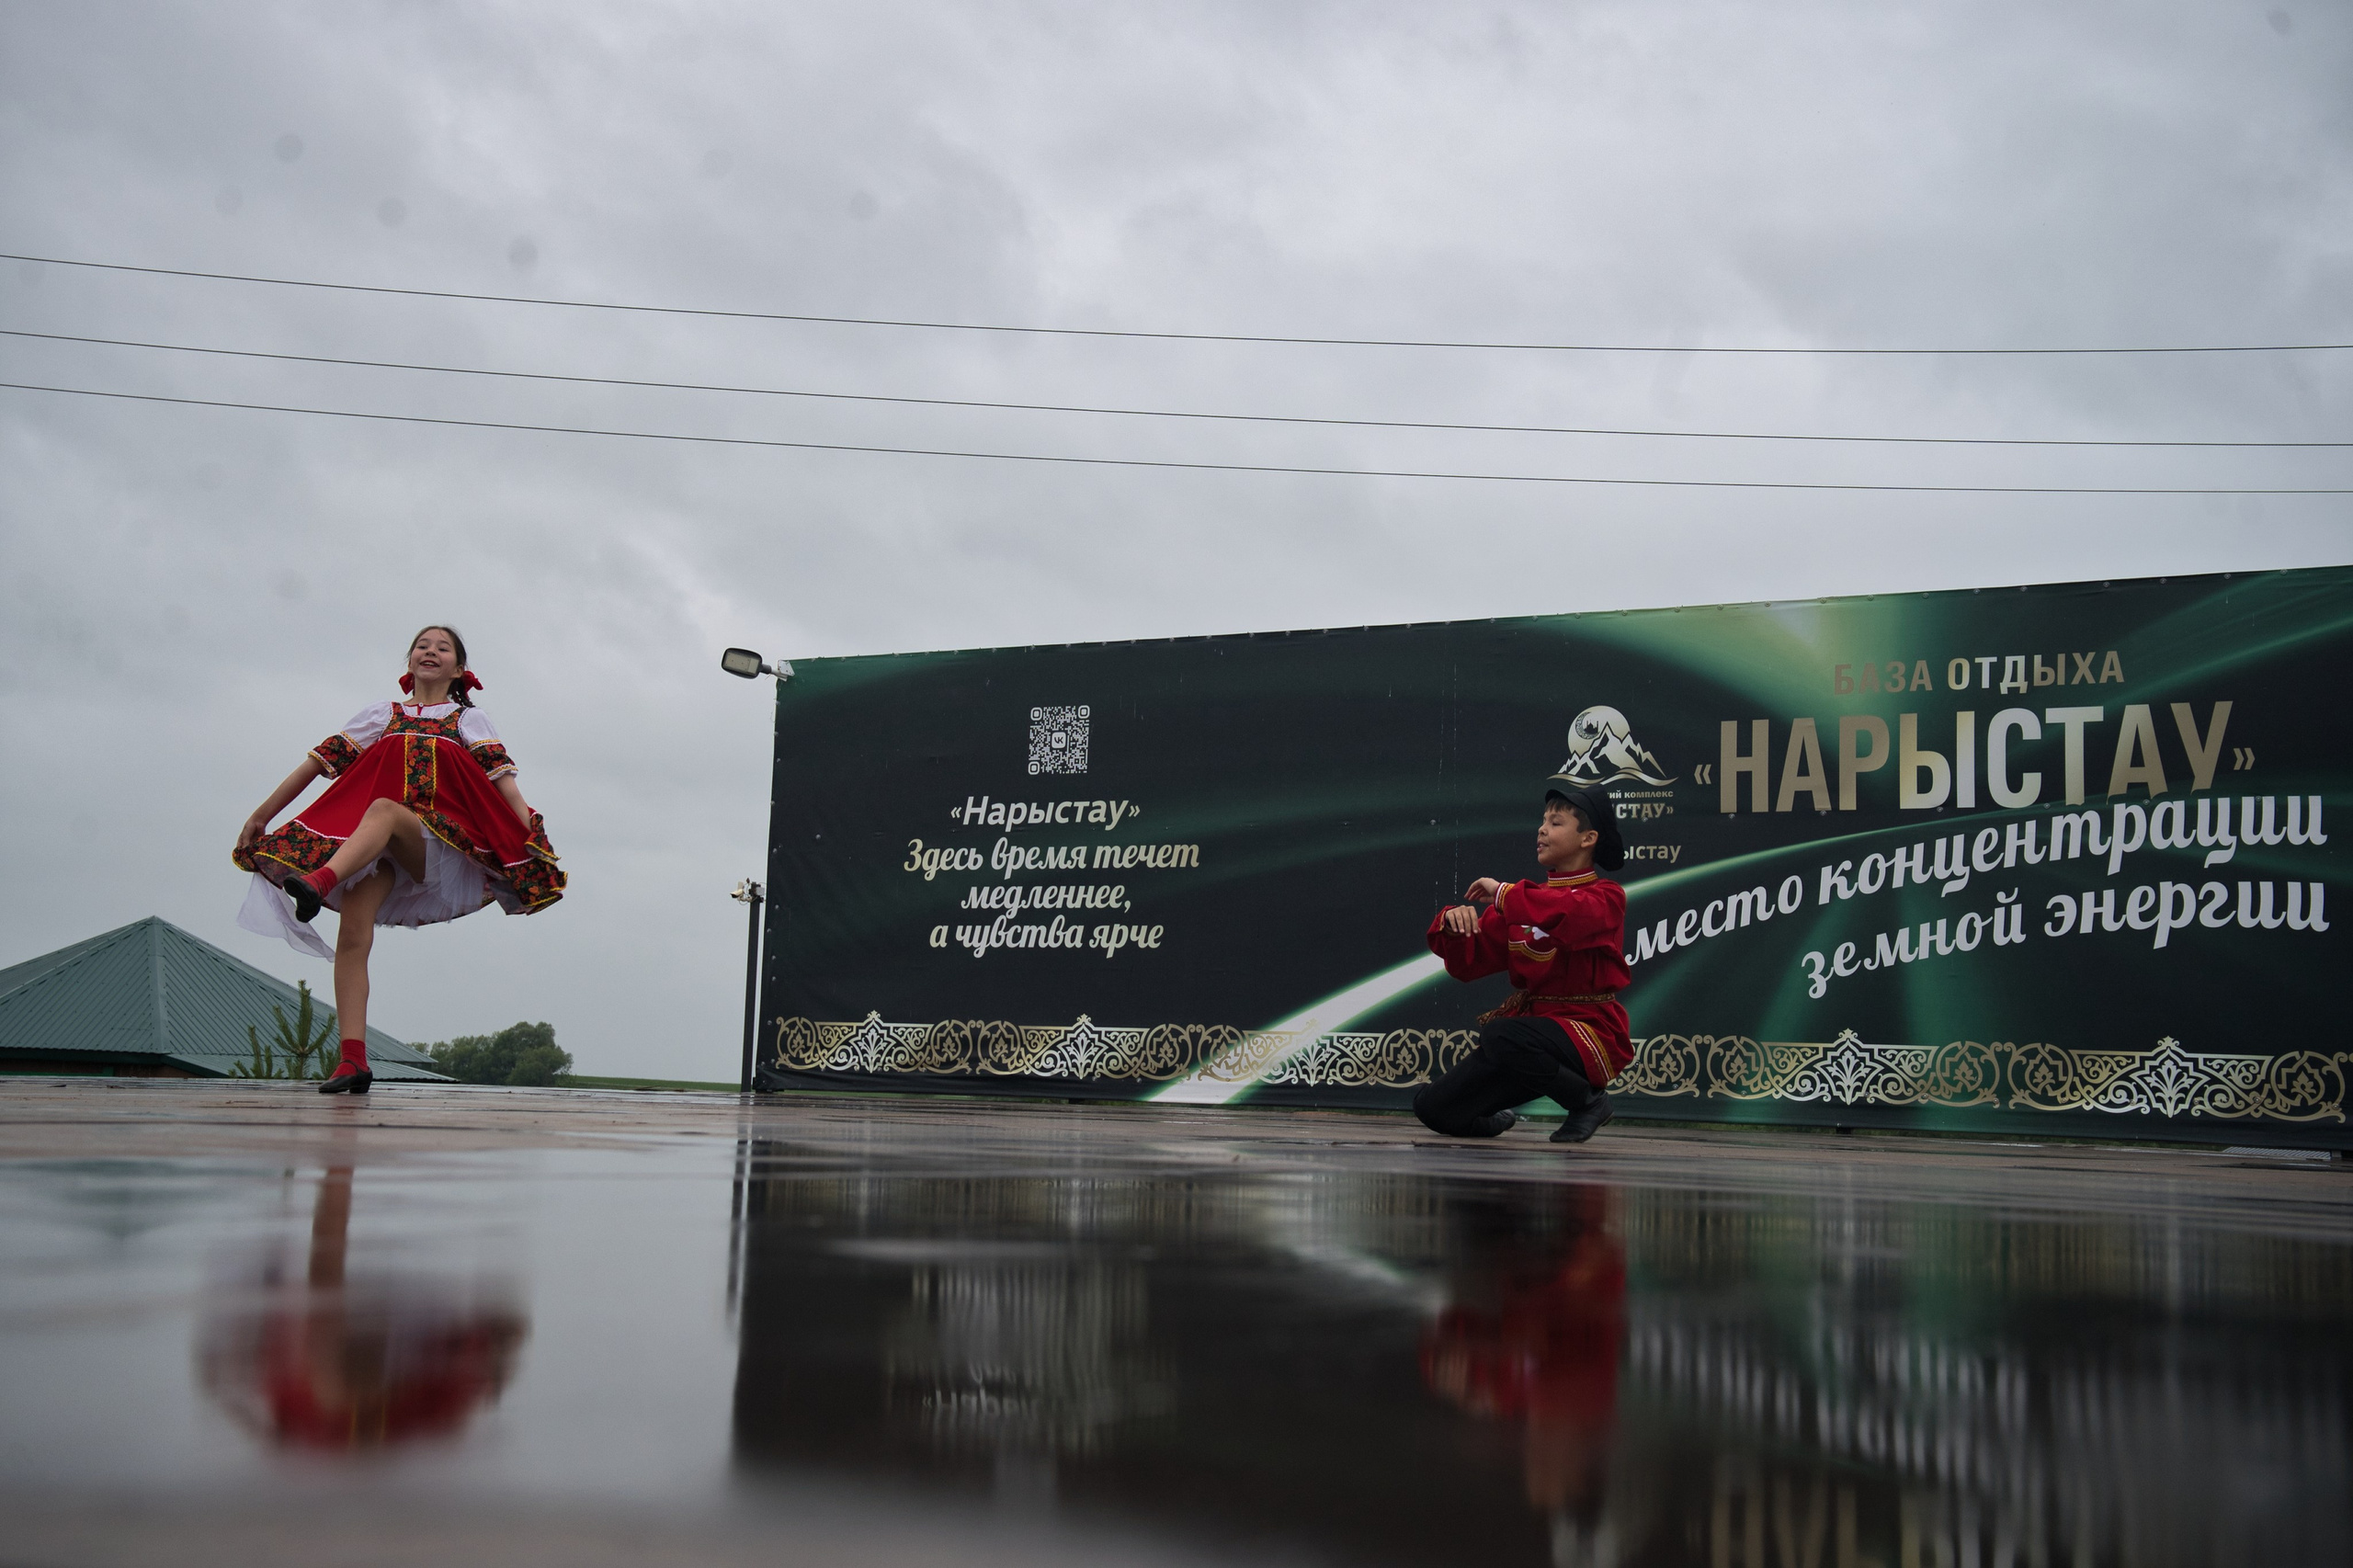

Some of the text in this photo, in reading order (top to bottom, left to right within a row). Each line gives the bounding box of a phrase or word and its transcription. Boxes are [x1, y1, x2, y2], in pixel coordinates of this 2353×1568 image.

[1834, 651, 2125, 695] БАЗА ОТДЫХА
[1693, 700, 2256, 813] «НАРЫСТАУ»
[950, 796, 1141, 832] «Нарыстау»
[1612, 802, 1674, 819] СТАУ»
[1624, 790, 1674, 799] комплекс
[904, 837, 1200, 881] Здесь время течет
[1624, 795, 2328, 966] место концентрации
[961, 884, 1131, 919] медленнее,
[929, 915, 1164, 959] а чувства ярче
[1801, 881, 2330, 999] земной энергии
